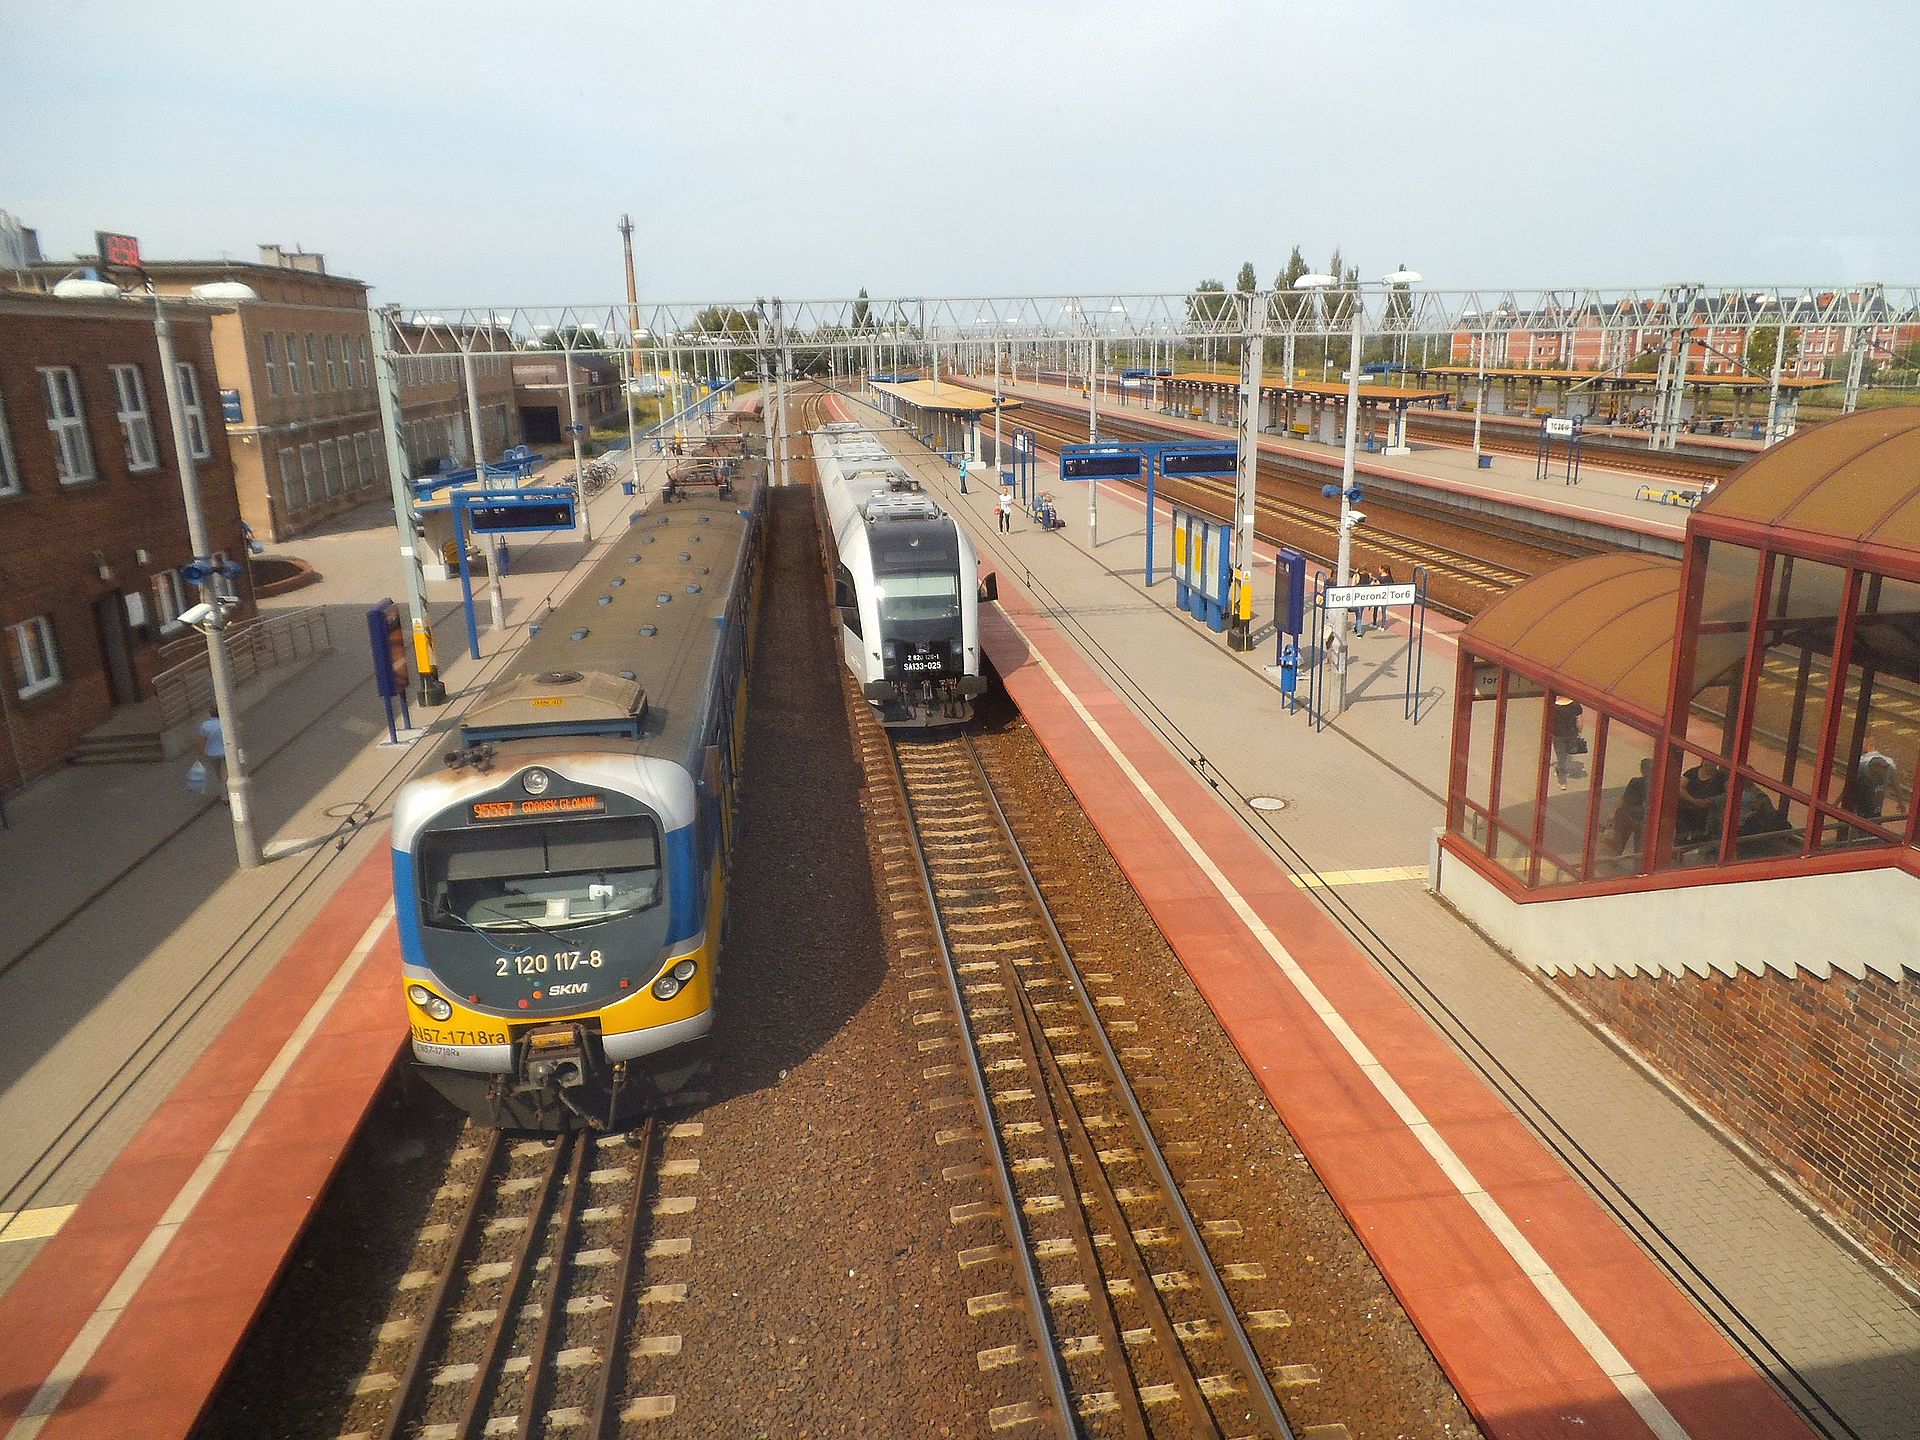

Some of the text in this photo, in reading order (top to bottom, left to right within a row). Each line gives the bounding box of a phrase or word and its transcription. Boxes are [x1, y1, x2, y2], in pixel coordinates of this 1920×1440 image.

[903, 661, 942, 671] SA133-025
[495, 950, 602, 977] 2 120 117-8
[548, 982, 589, 996] SKM
